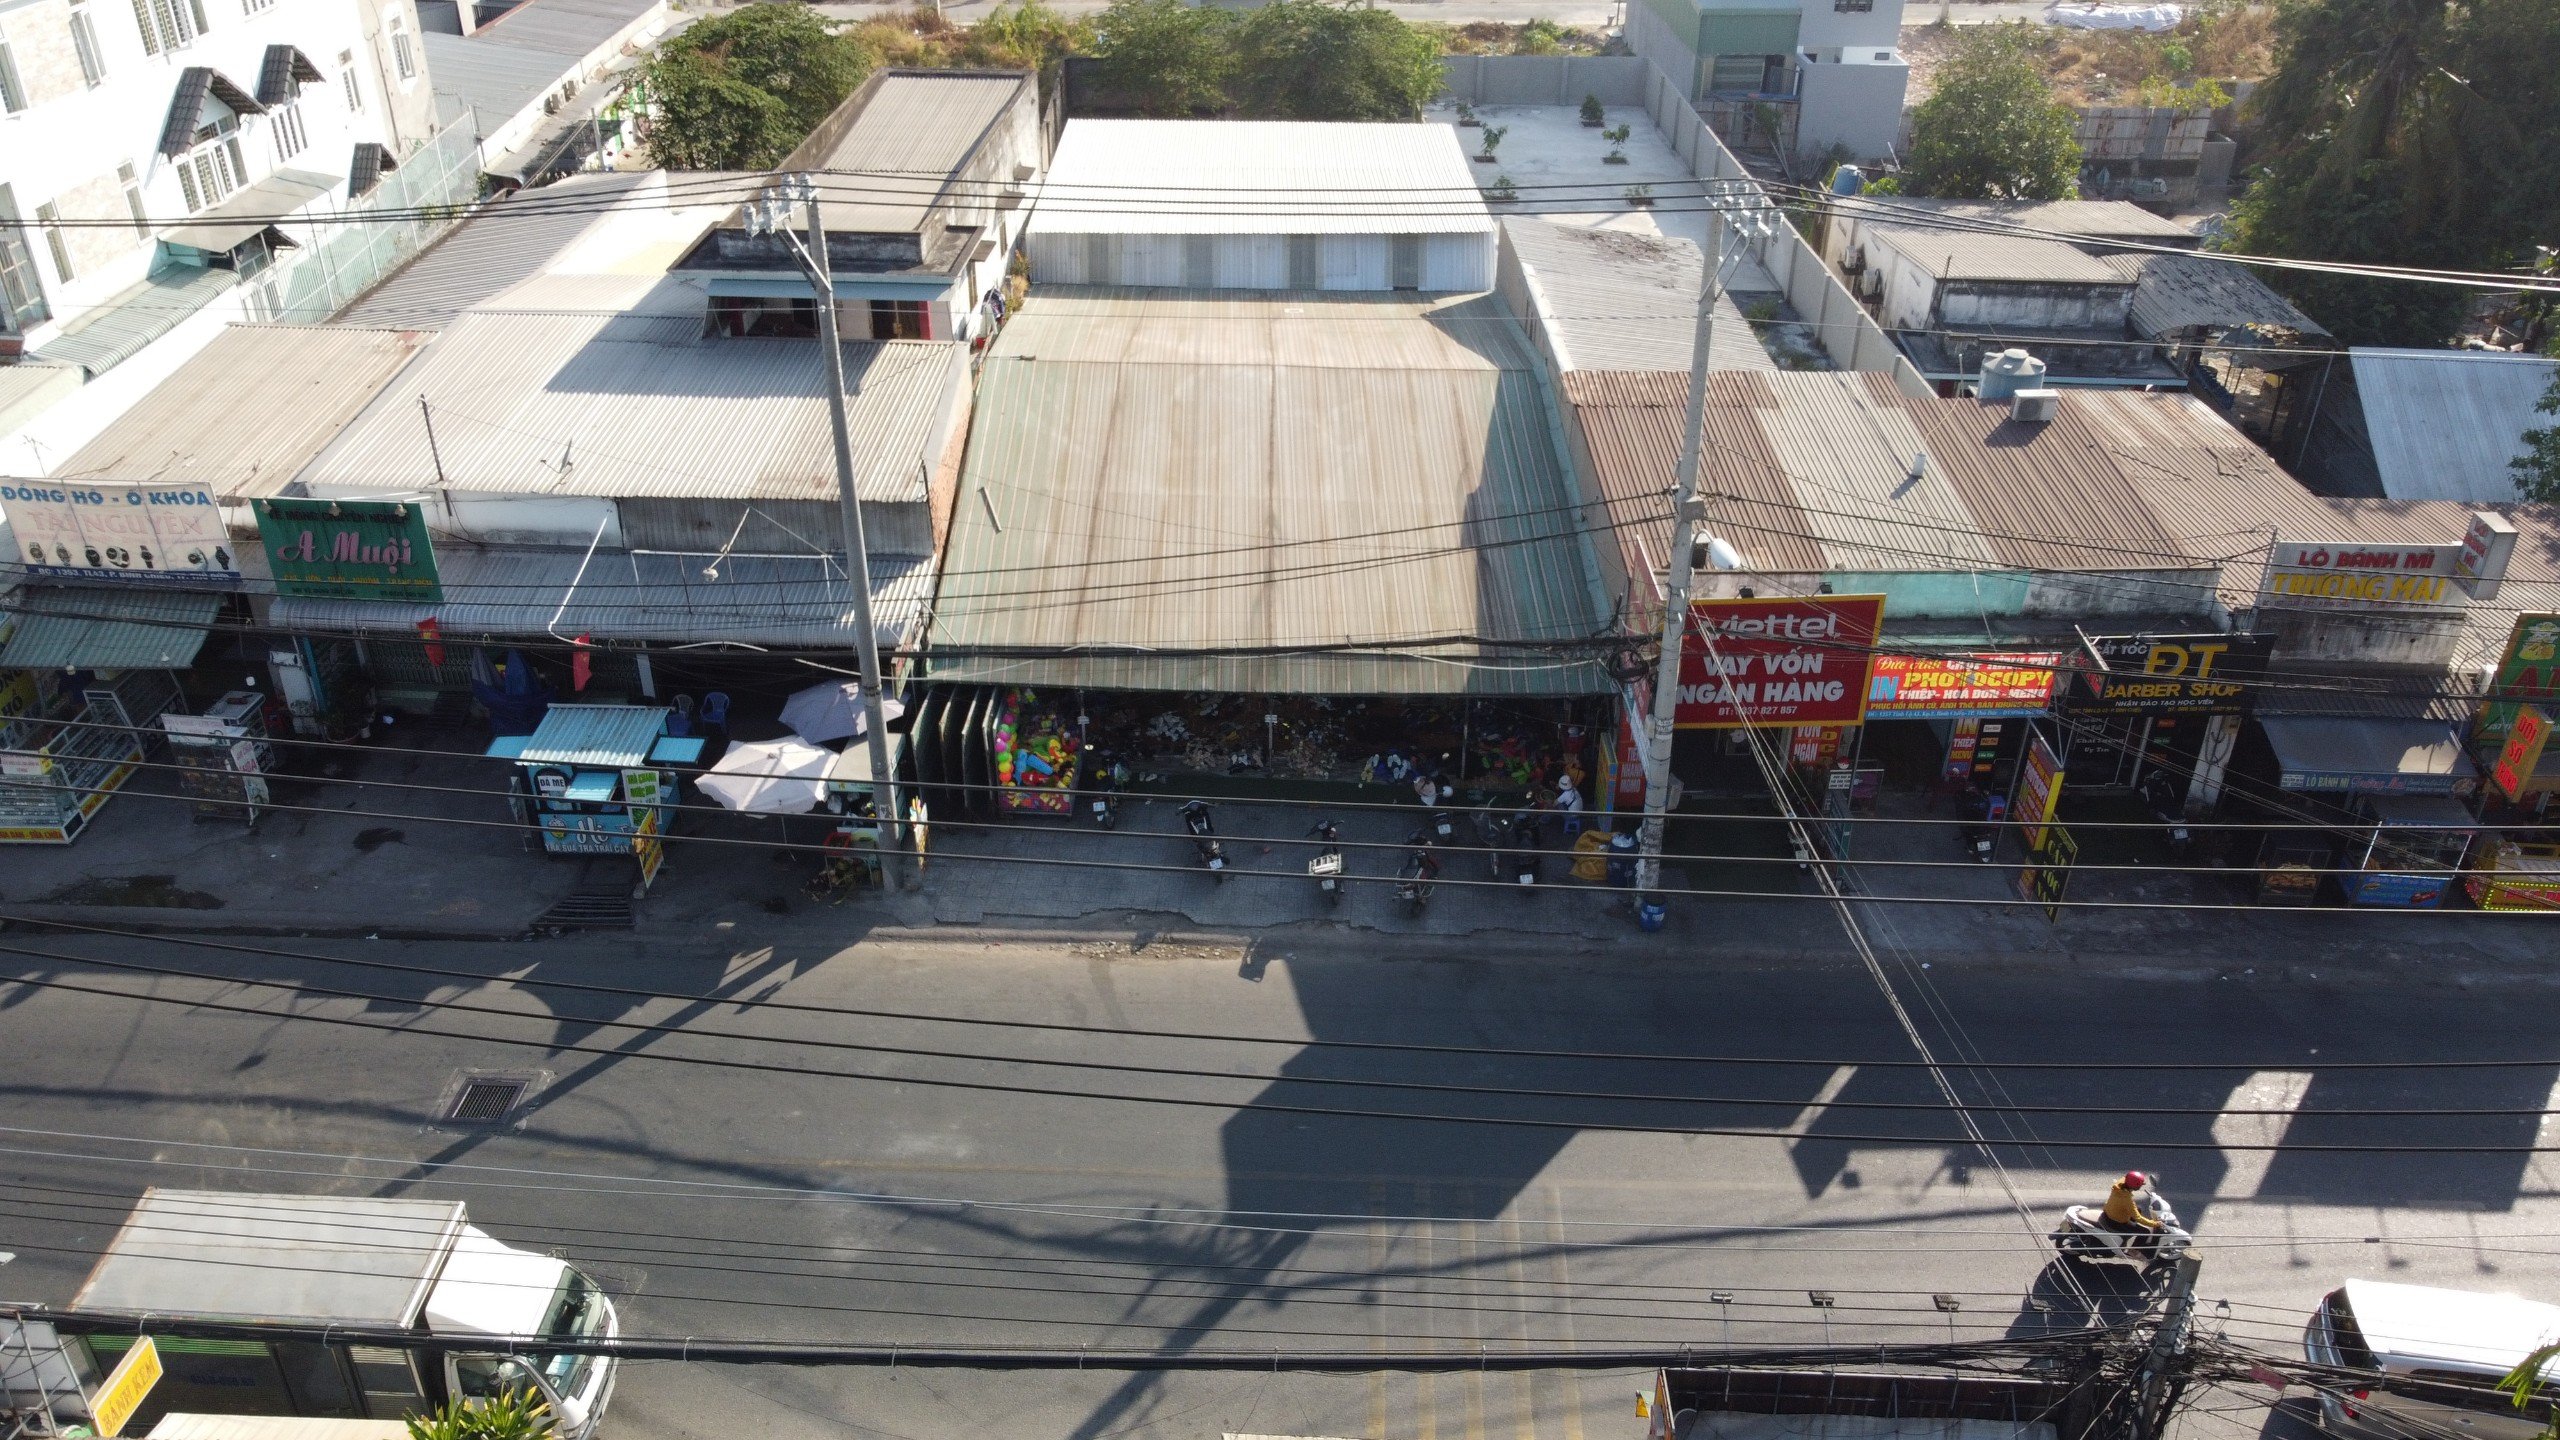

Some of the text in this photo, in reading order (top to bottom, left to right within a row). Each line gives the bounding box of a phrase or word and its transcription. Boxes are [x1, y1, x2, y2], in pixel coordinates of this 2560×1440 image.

[2297, 546, 2436, 569] LÒ BÁNH MÌ
[2391, 576, 2446, 604] MAI
[1703, 645, 1824, 677] VAY VỐN
[2121, 640, 2148, 655] TÓC
[1763, 676, 1845, 703] HÀNG
[1869, 676, 1900, 702] IN
[1903, 670, 2054, 688] PHOTOCOPY
[2008, 687, 2048, 700] MENU
[2104, 682, 2245, 698] BARBER SHOP
[102, 1357, 157, 1432] BÁNH KEM
